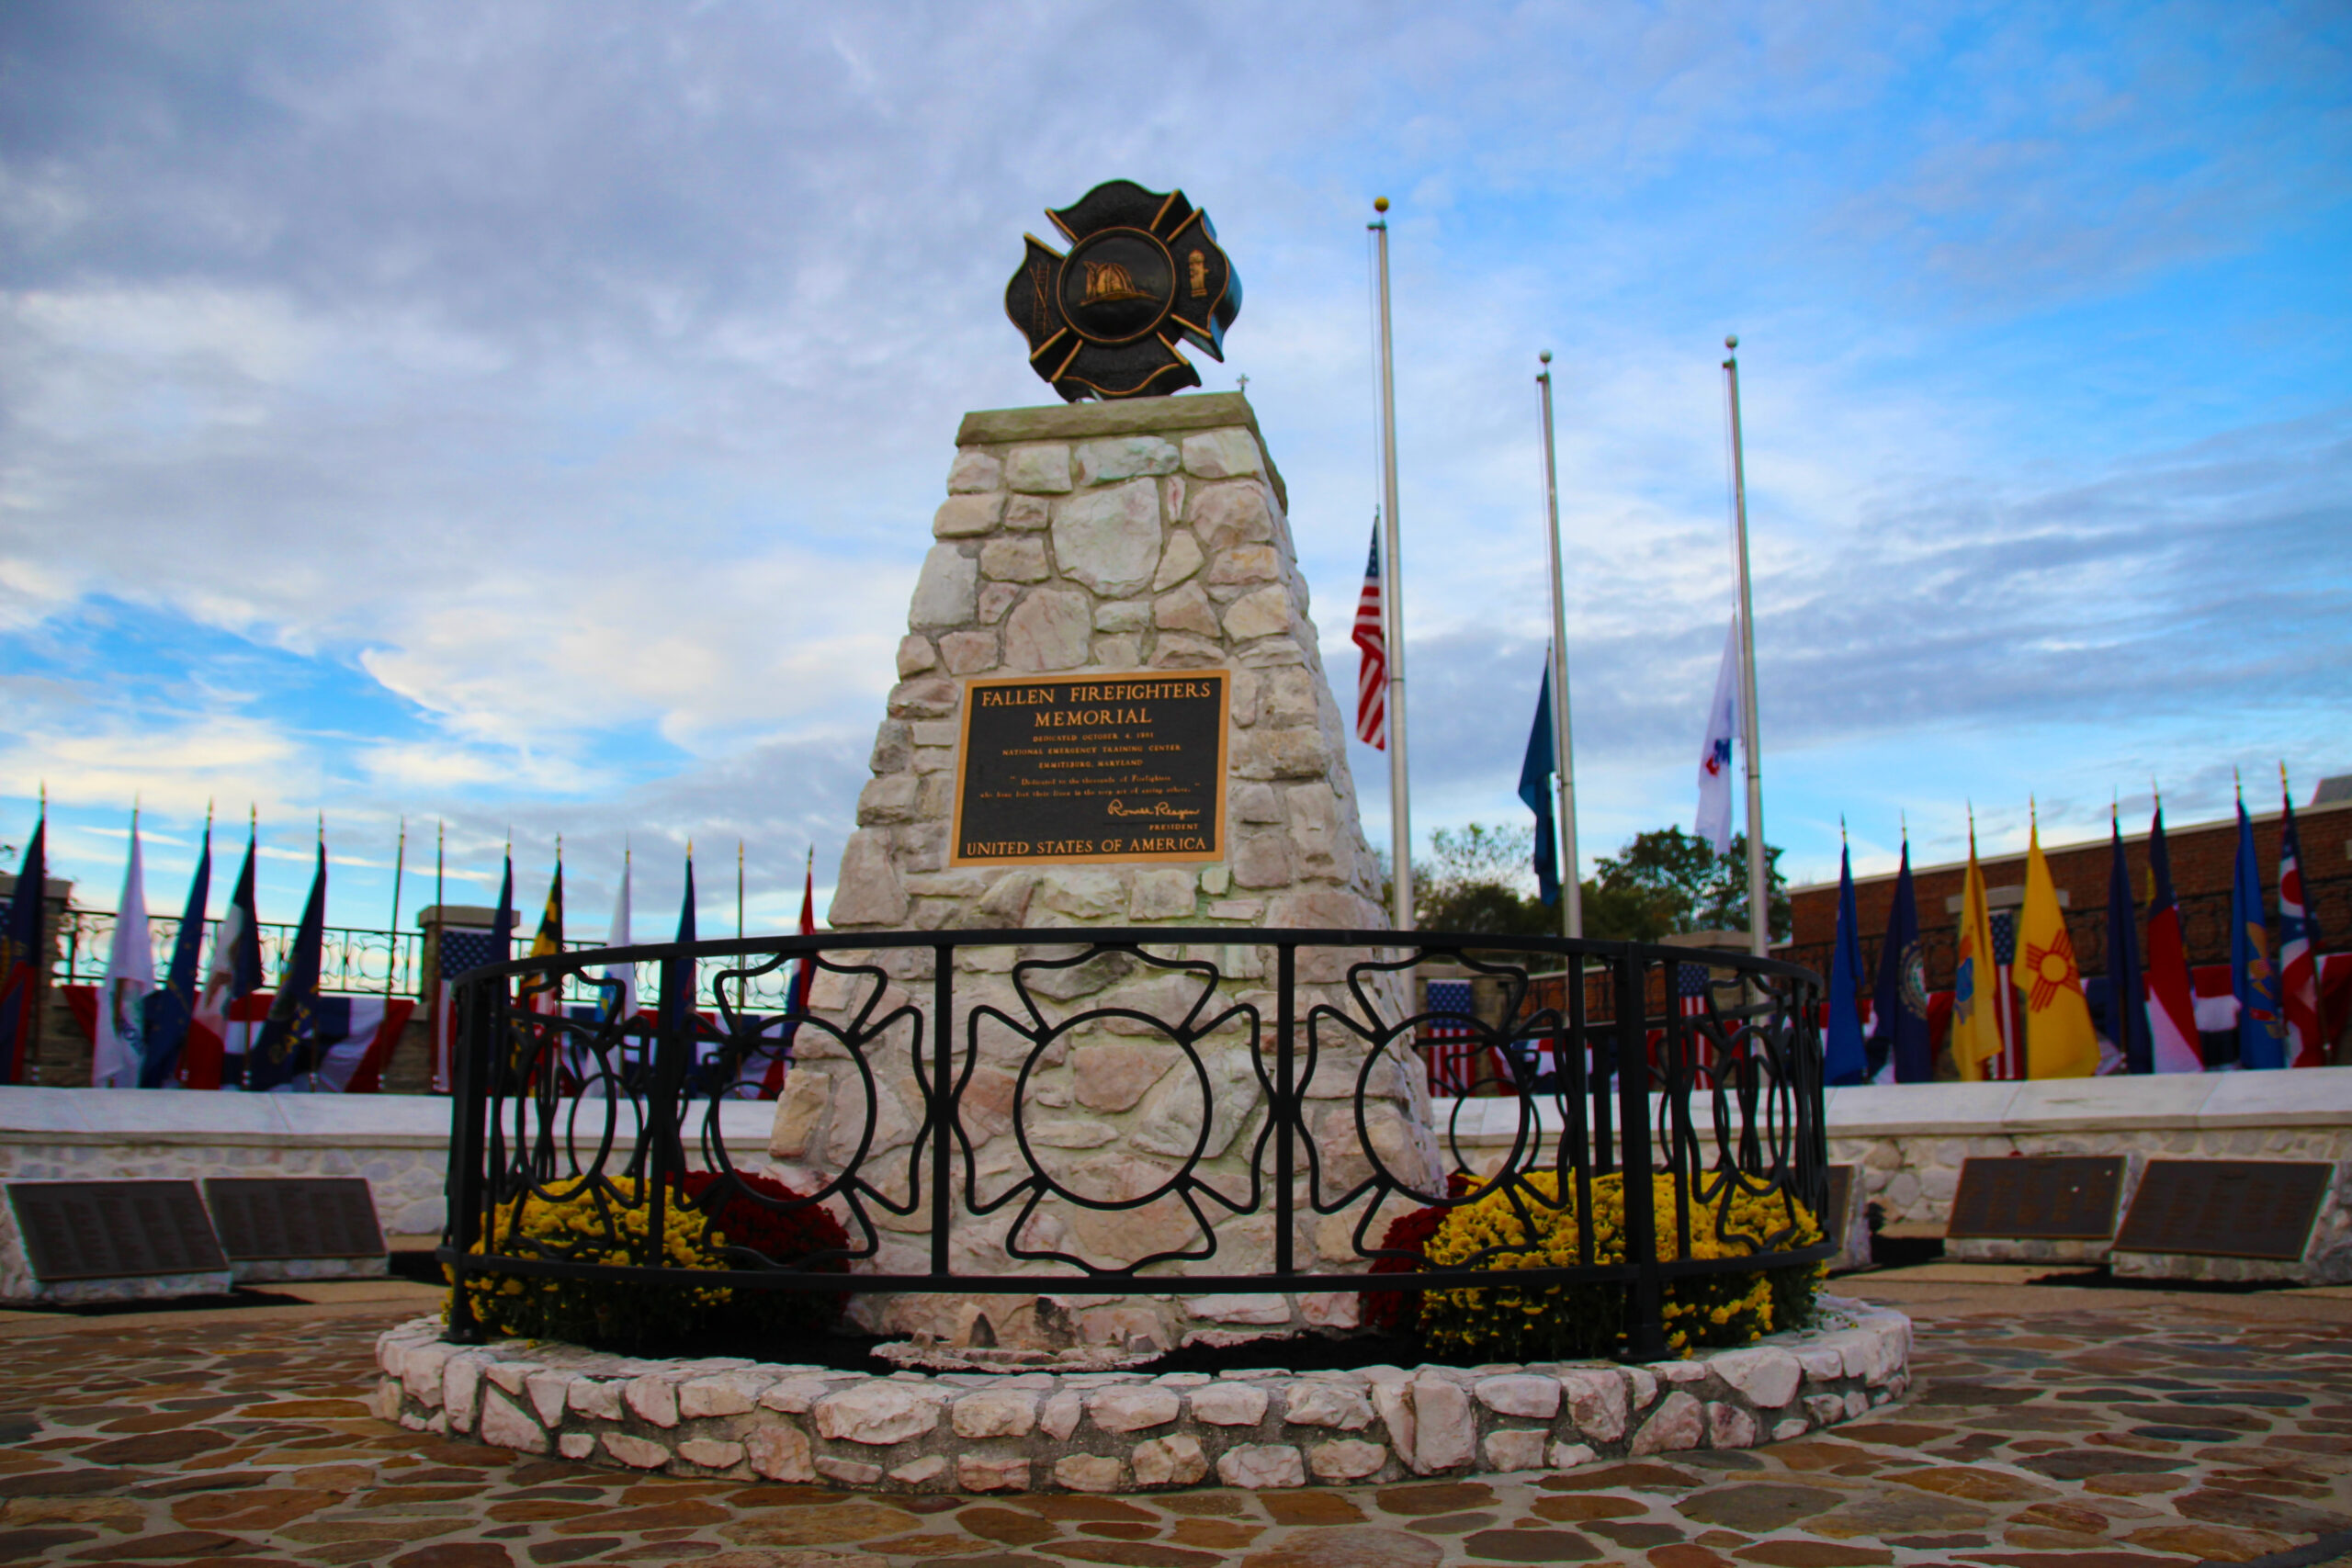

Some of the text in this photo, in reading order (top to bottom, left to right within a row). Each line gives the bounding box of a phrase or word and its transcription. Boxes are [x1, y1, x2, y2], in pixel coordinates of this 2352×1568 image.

[982, 682, 1212, 707] FALLEN FIREFIGHTERS
[1035, 707, 1152, 728] MEMORIAL
[1033, 734, 1078, 742] DEDICATED
[1082, 733, 1119, 741] OCTOBER
[1048, 747, 1098, 755] EMERGENCY
[1102, 745, 1144, 753] TRAINING
[1098, 759, 1144, 767] MARYLAND
[1155, 801, 1201, 820] Reagan
[1149, 823, 1199, 831] PRESIDENT
[967, 837, 1206, 856] UNITED STATES OF AMERICA
